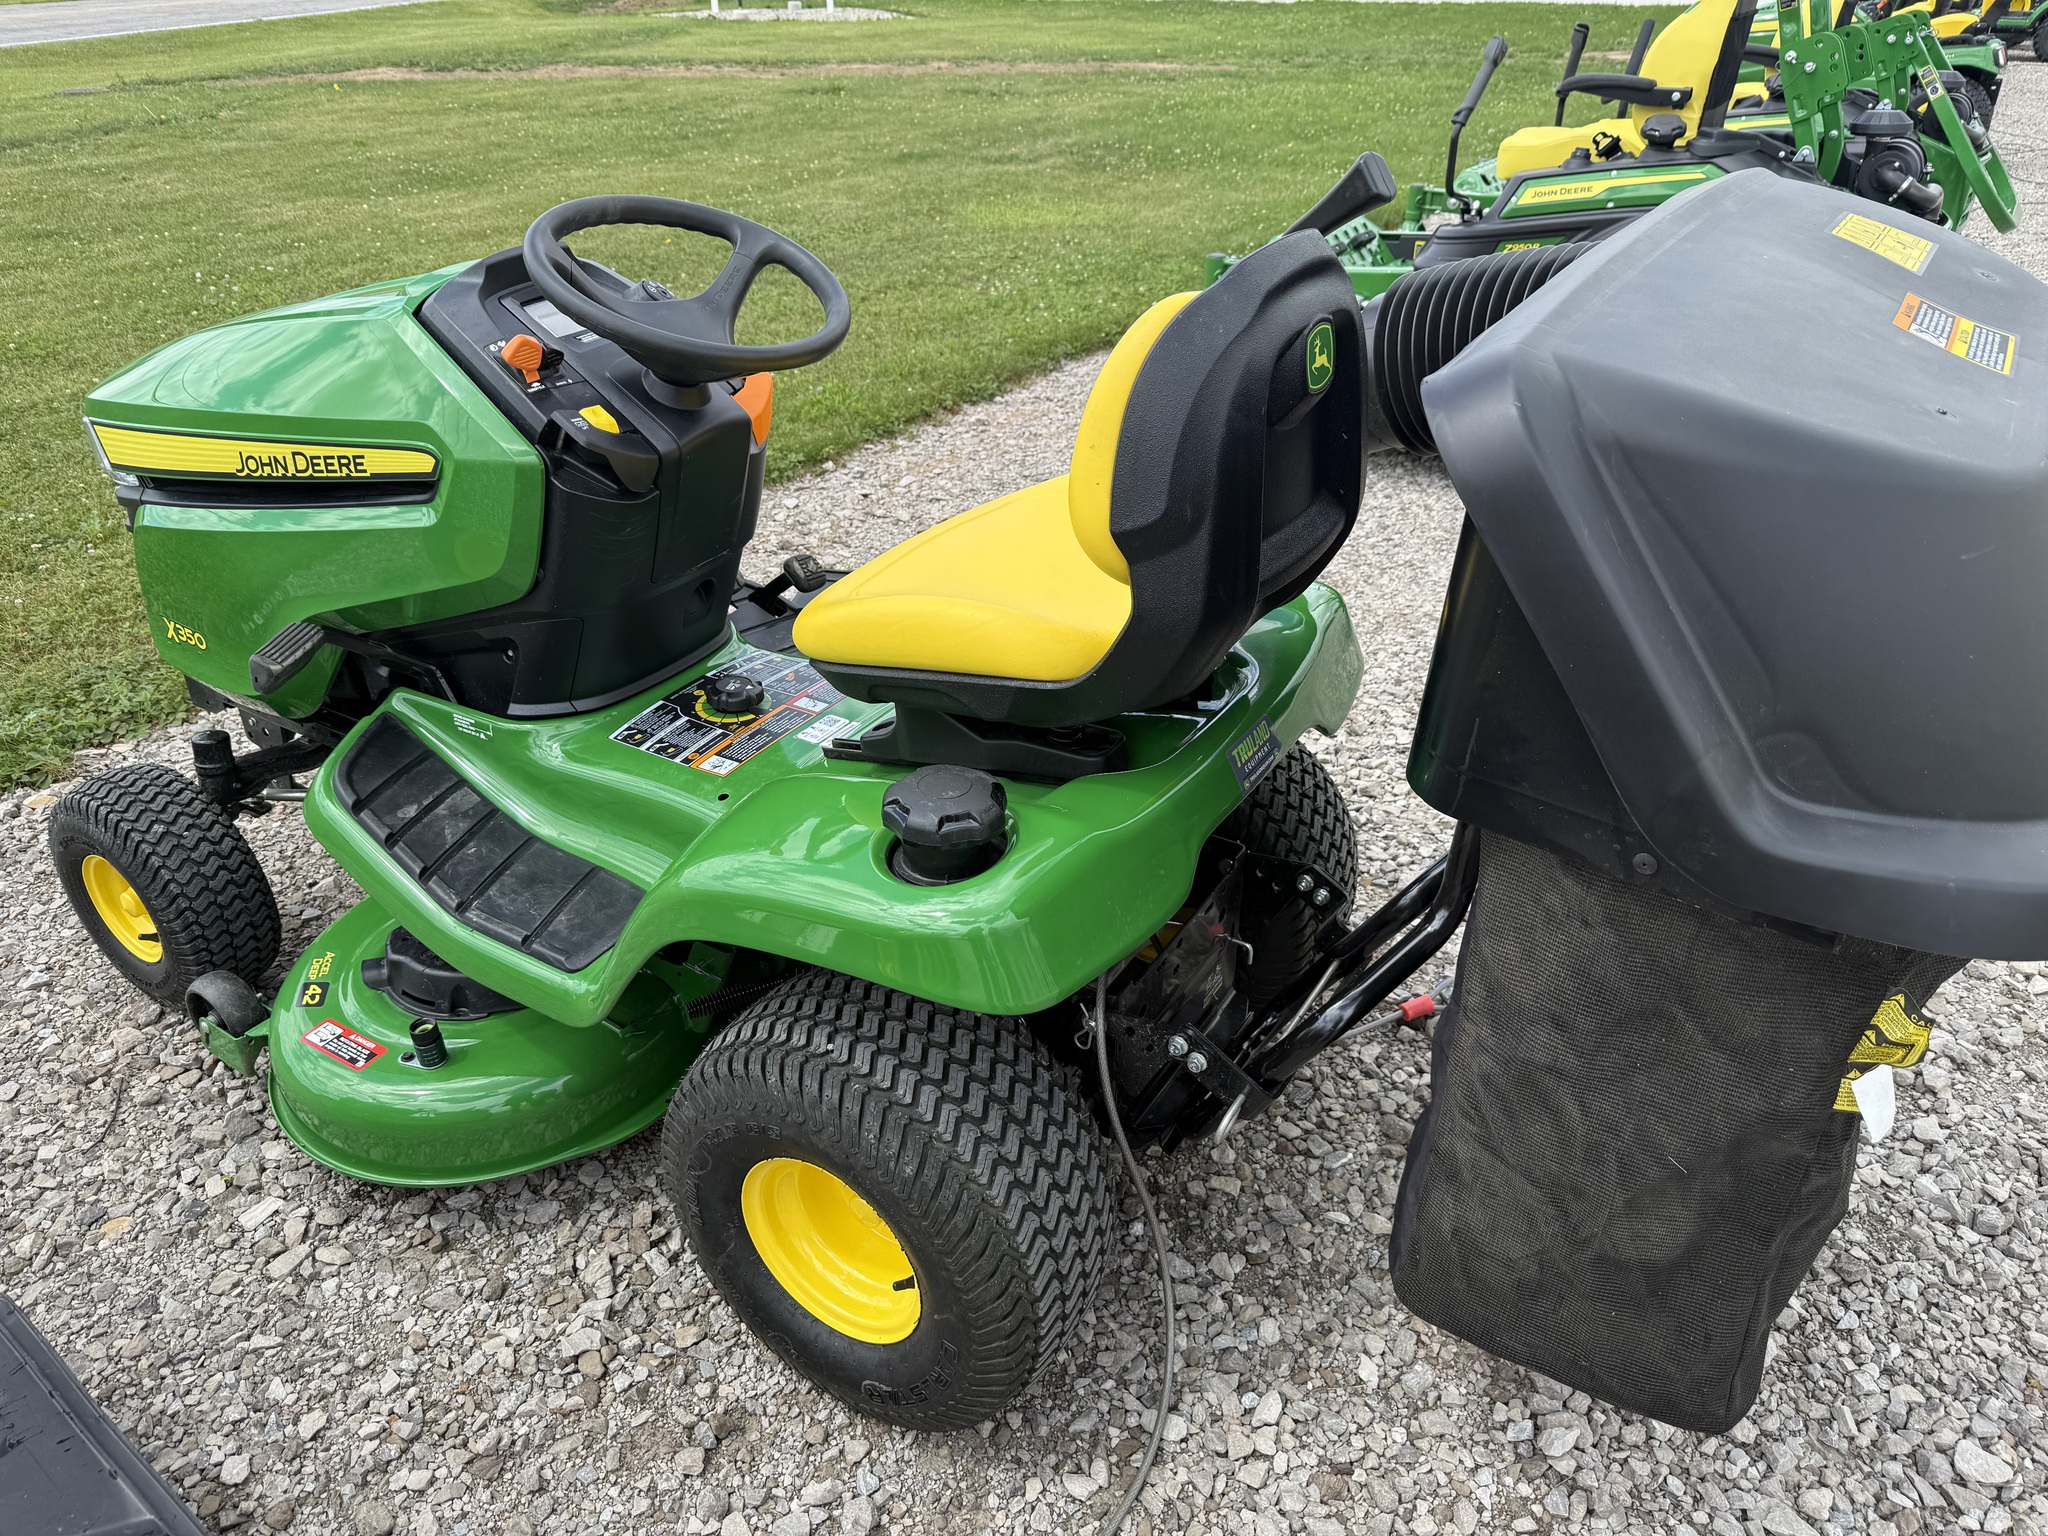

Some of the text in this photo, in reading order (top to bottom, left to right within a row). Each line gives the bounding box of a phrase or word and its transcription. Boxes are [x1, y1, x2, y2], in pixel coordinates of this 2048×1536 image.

[1531, 186, 1593, 199] JOHN DEERE
[235, 451, 368, 475] JOHN DEERE
[162, 617, 207, 650] X350
[1231, 720, 1271, 768] TRULAND
[1244, 742, 1271, 772] EQUIPMENT
[307, 958, 324, 981] DEEP
[318, 951, 336, 978] ACCEL
[301, 984, 323, 1006] 42
[355, 1034, 377, 1050] DANGER
